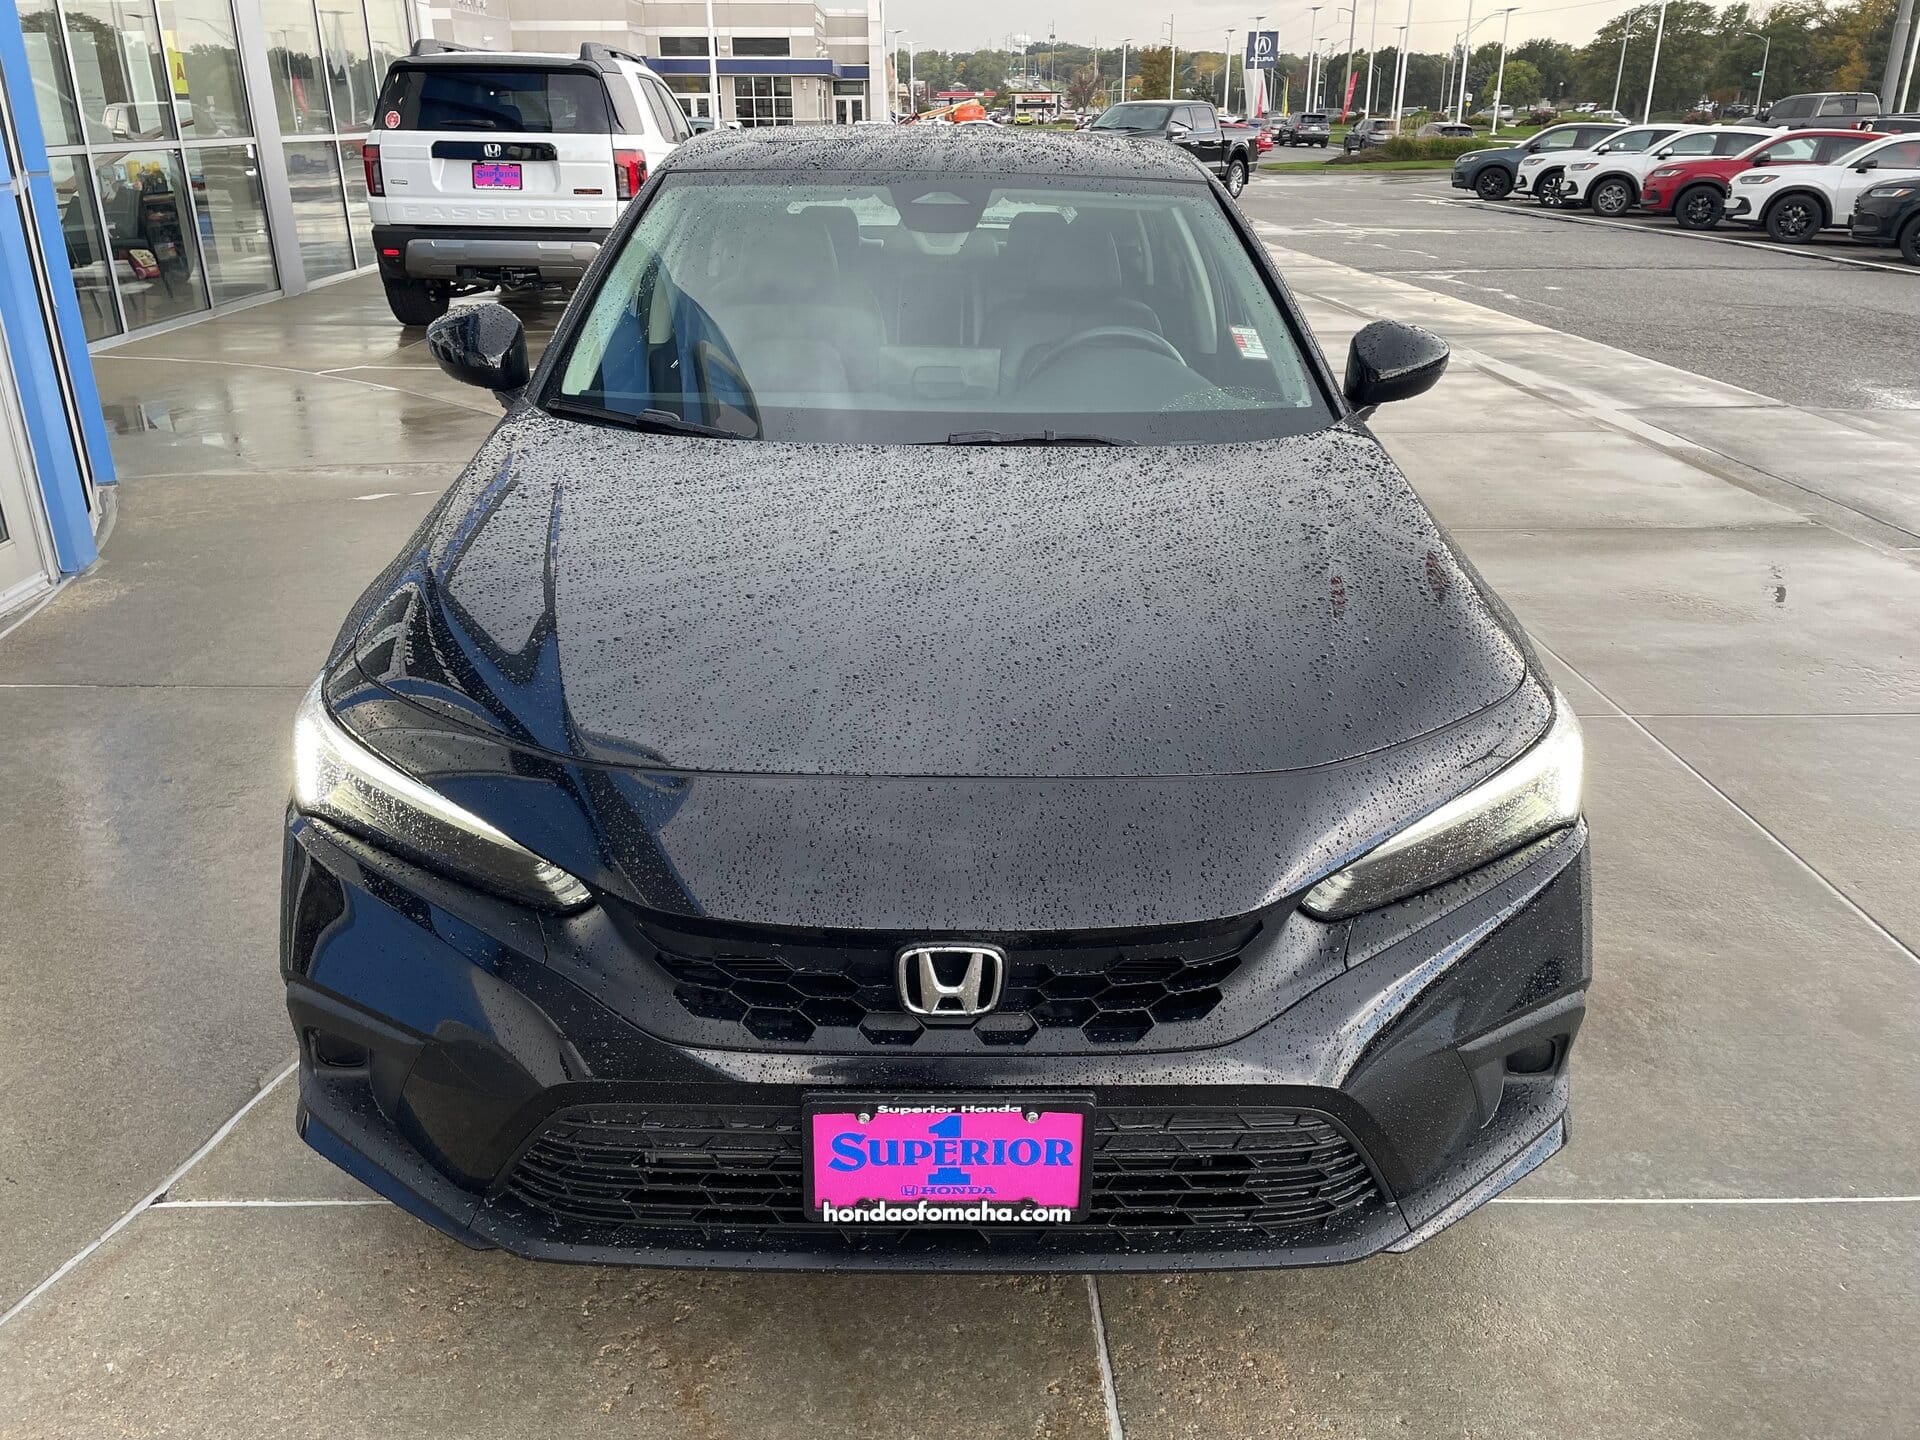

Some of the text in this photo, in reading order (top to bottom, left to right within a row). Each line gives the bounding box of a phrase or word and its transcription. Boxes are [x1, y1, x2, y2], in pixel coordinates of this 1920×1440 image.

[402, 205, 600, 222] PASSPORT
[877, 1105, 1022, 1114] Superior Honda
[828, 1132, 1074, 1172] SUPERIOR
[921, 1186, 997, 1195] HONDA
[823, 1200, 1071, 1223] hondaofomaha.com
